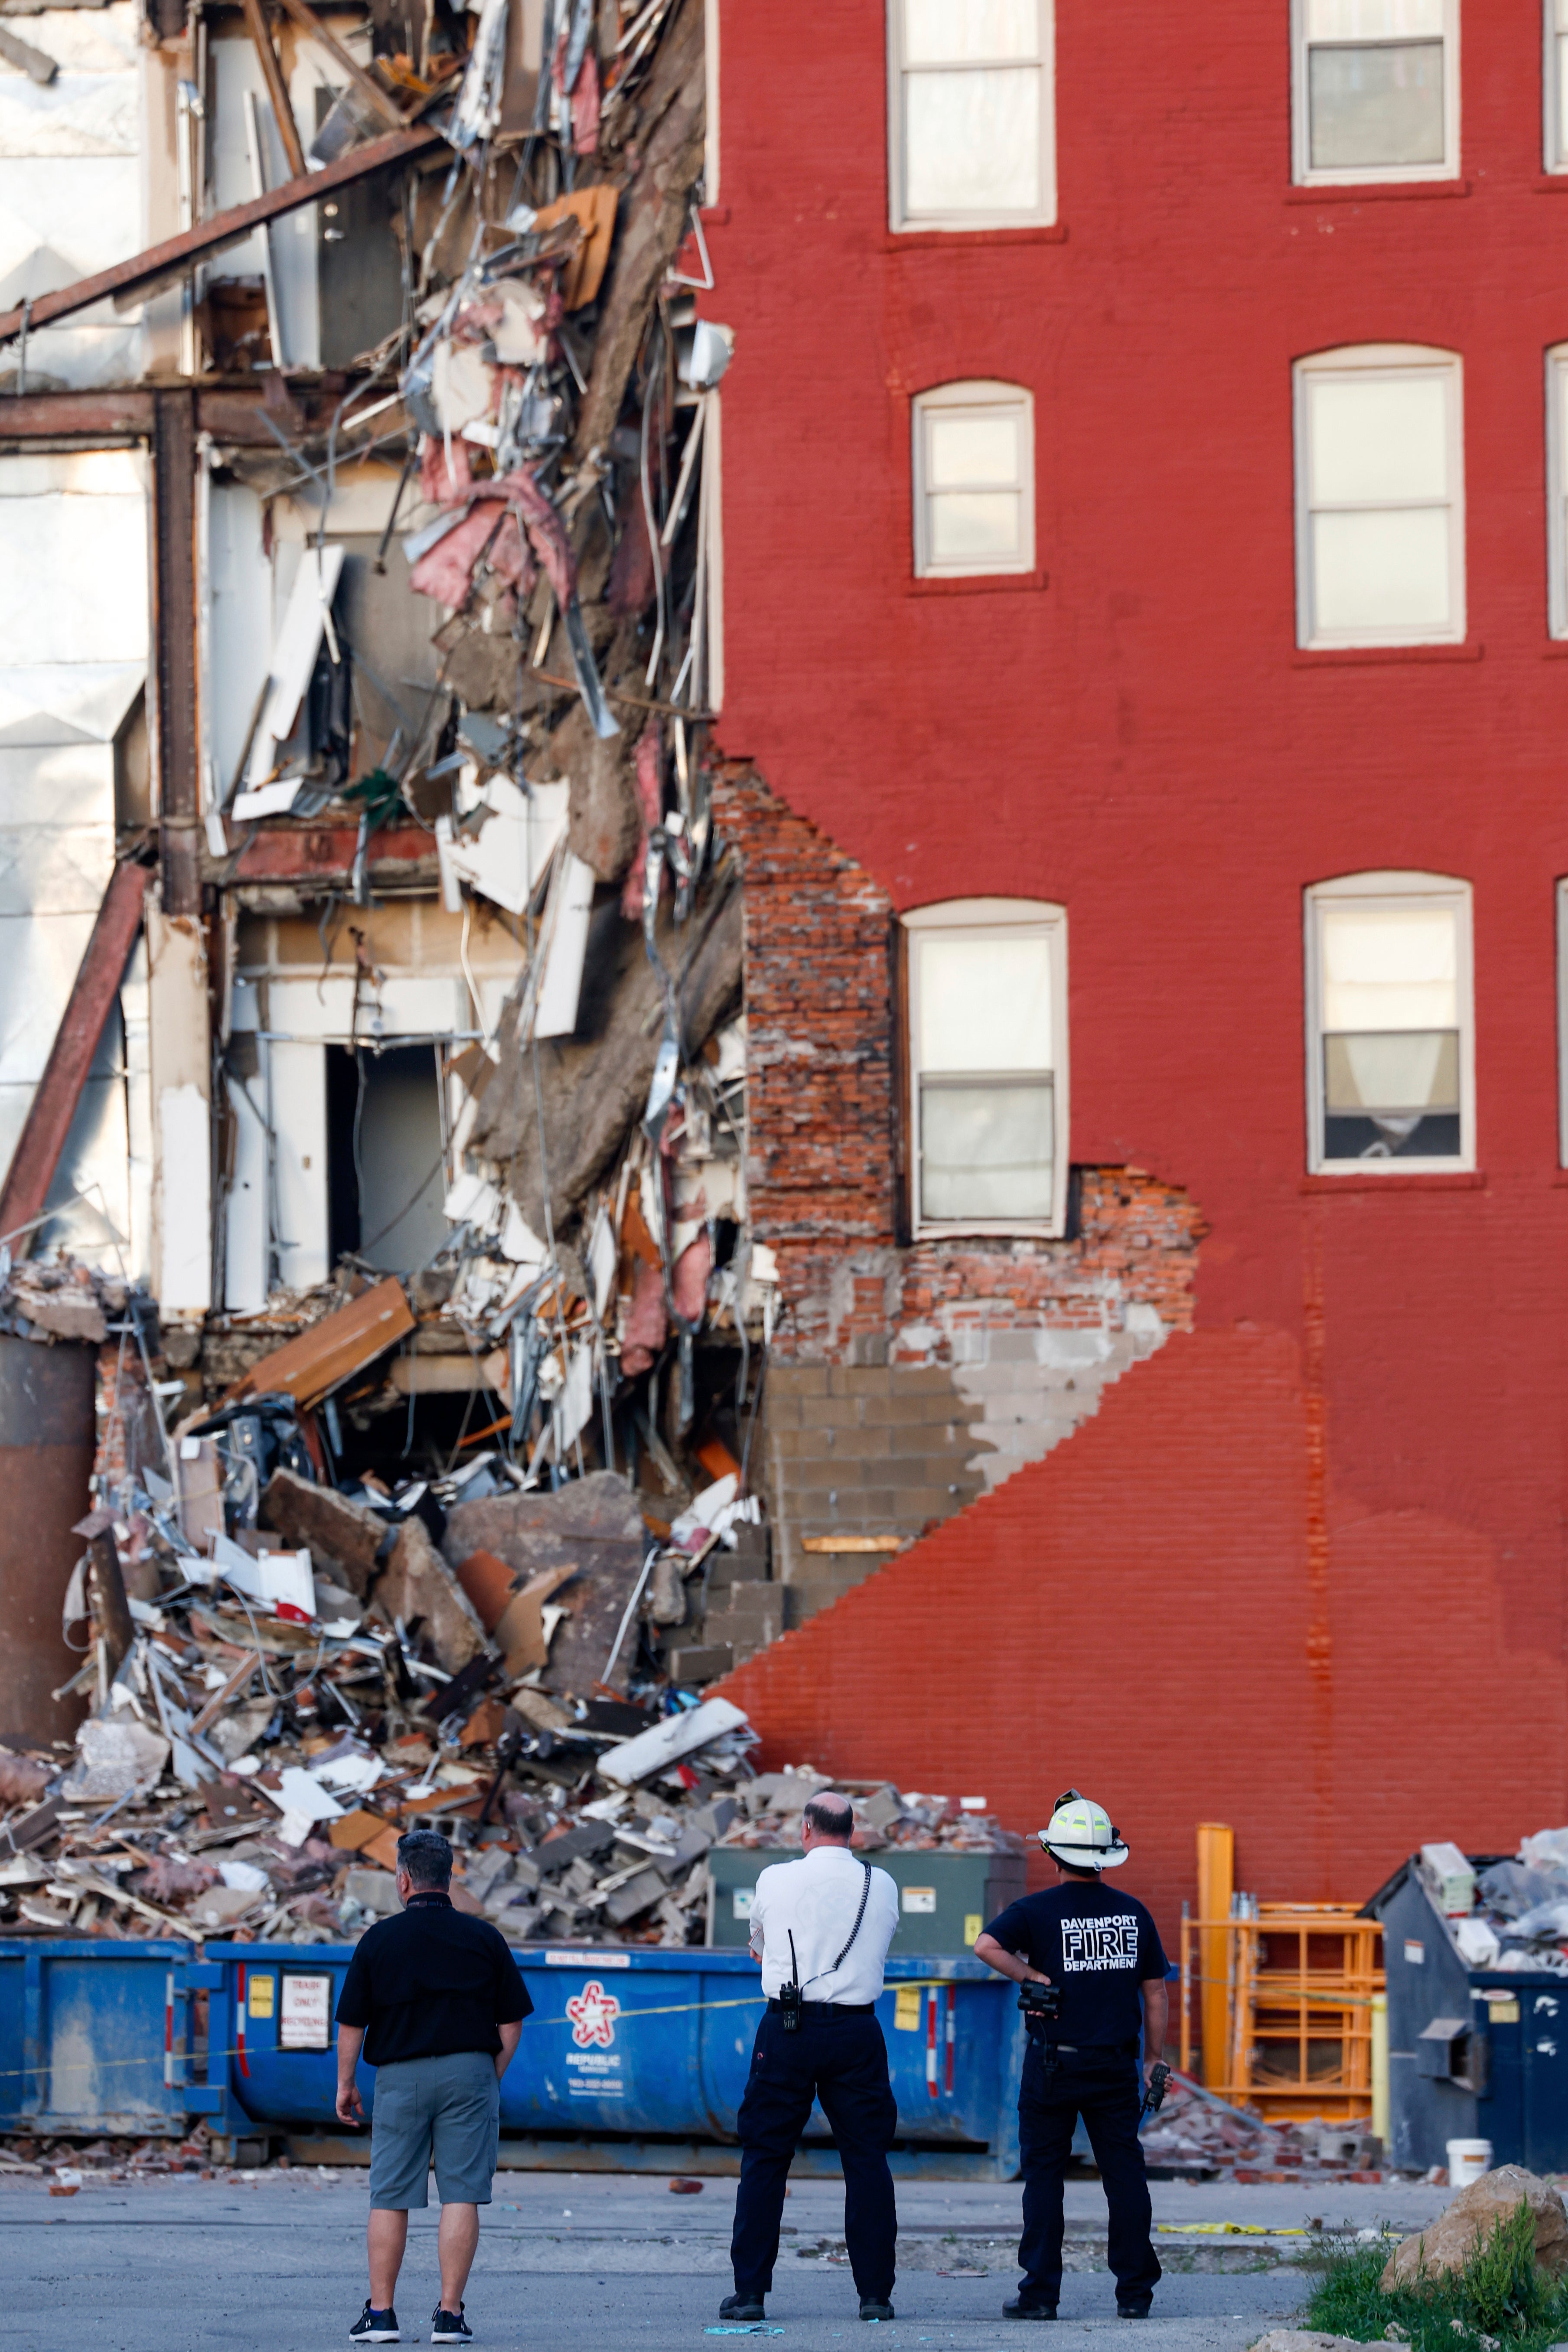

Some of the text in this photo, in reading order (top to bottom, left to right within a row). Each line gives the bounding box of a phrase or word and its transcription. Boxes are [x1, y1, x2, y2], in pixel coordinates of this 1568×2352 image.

[1061, 1915, 1137, 1930] DAVENPORT
[1062, 1926, 1138, 1961] FIRE
[1063, 1958, 1137, 1972] DEPARTMENT
